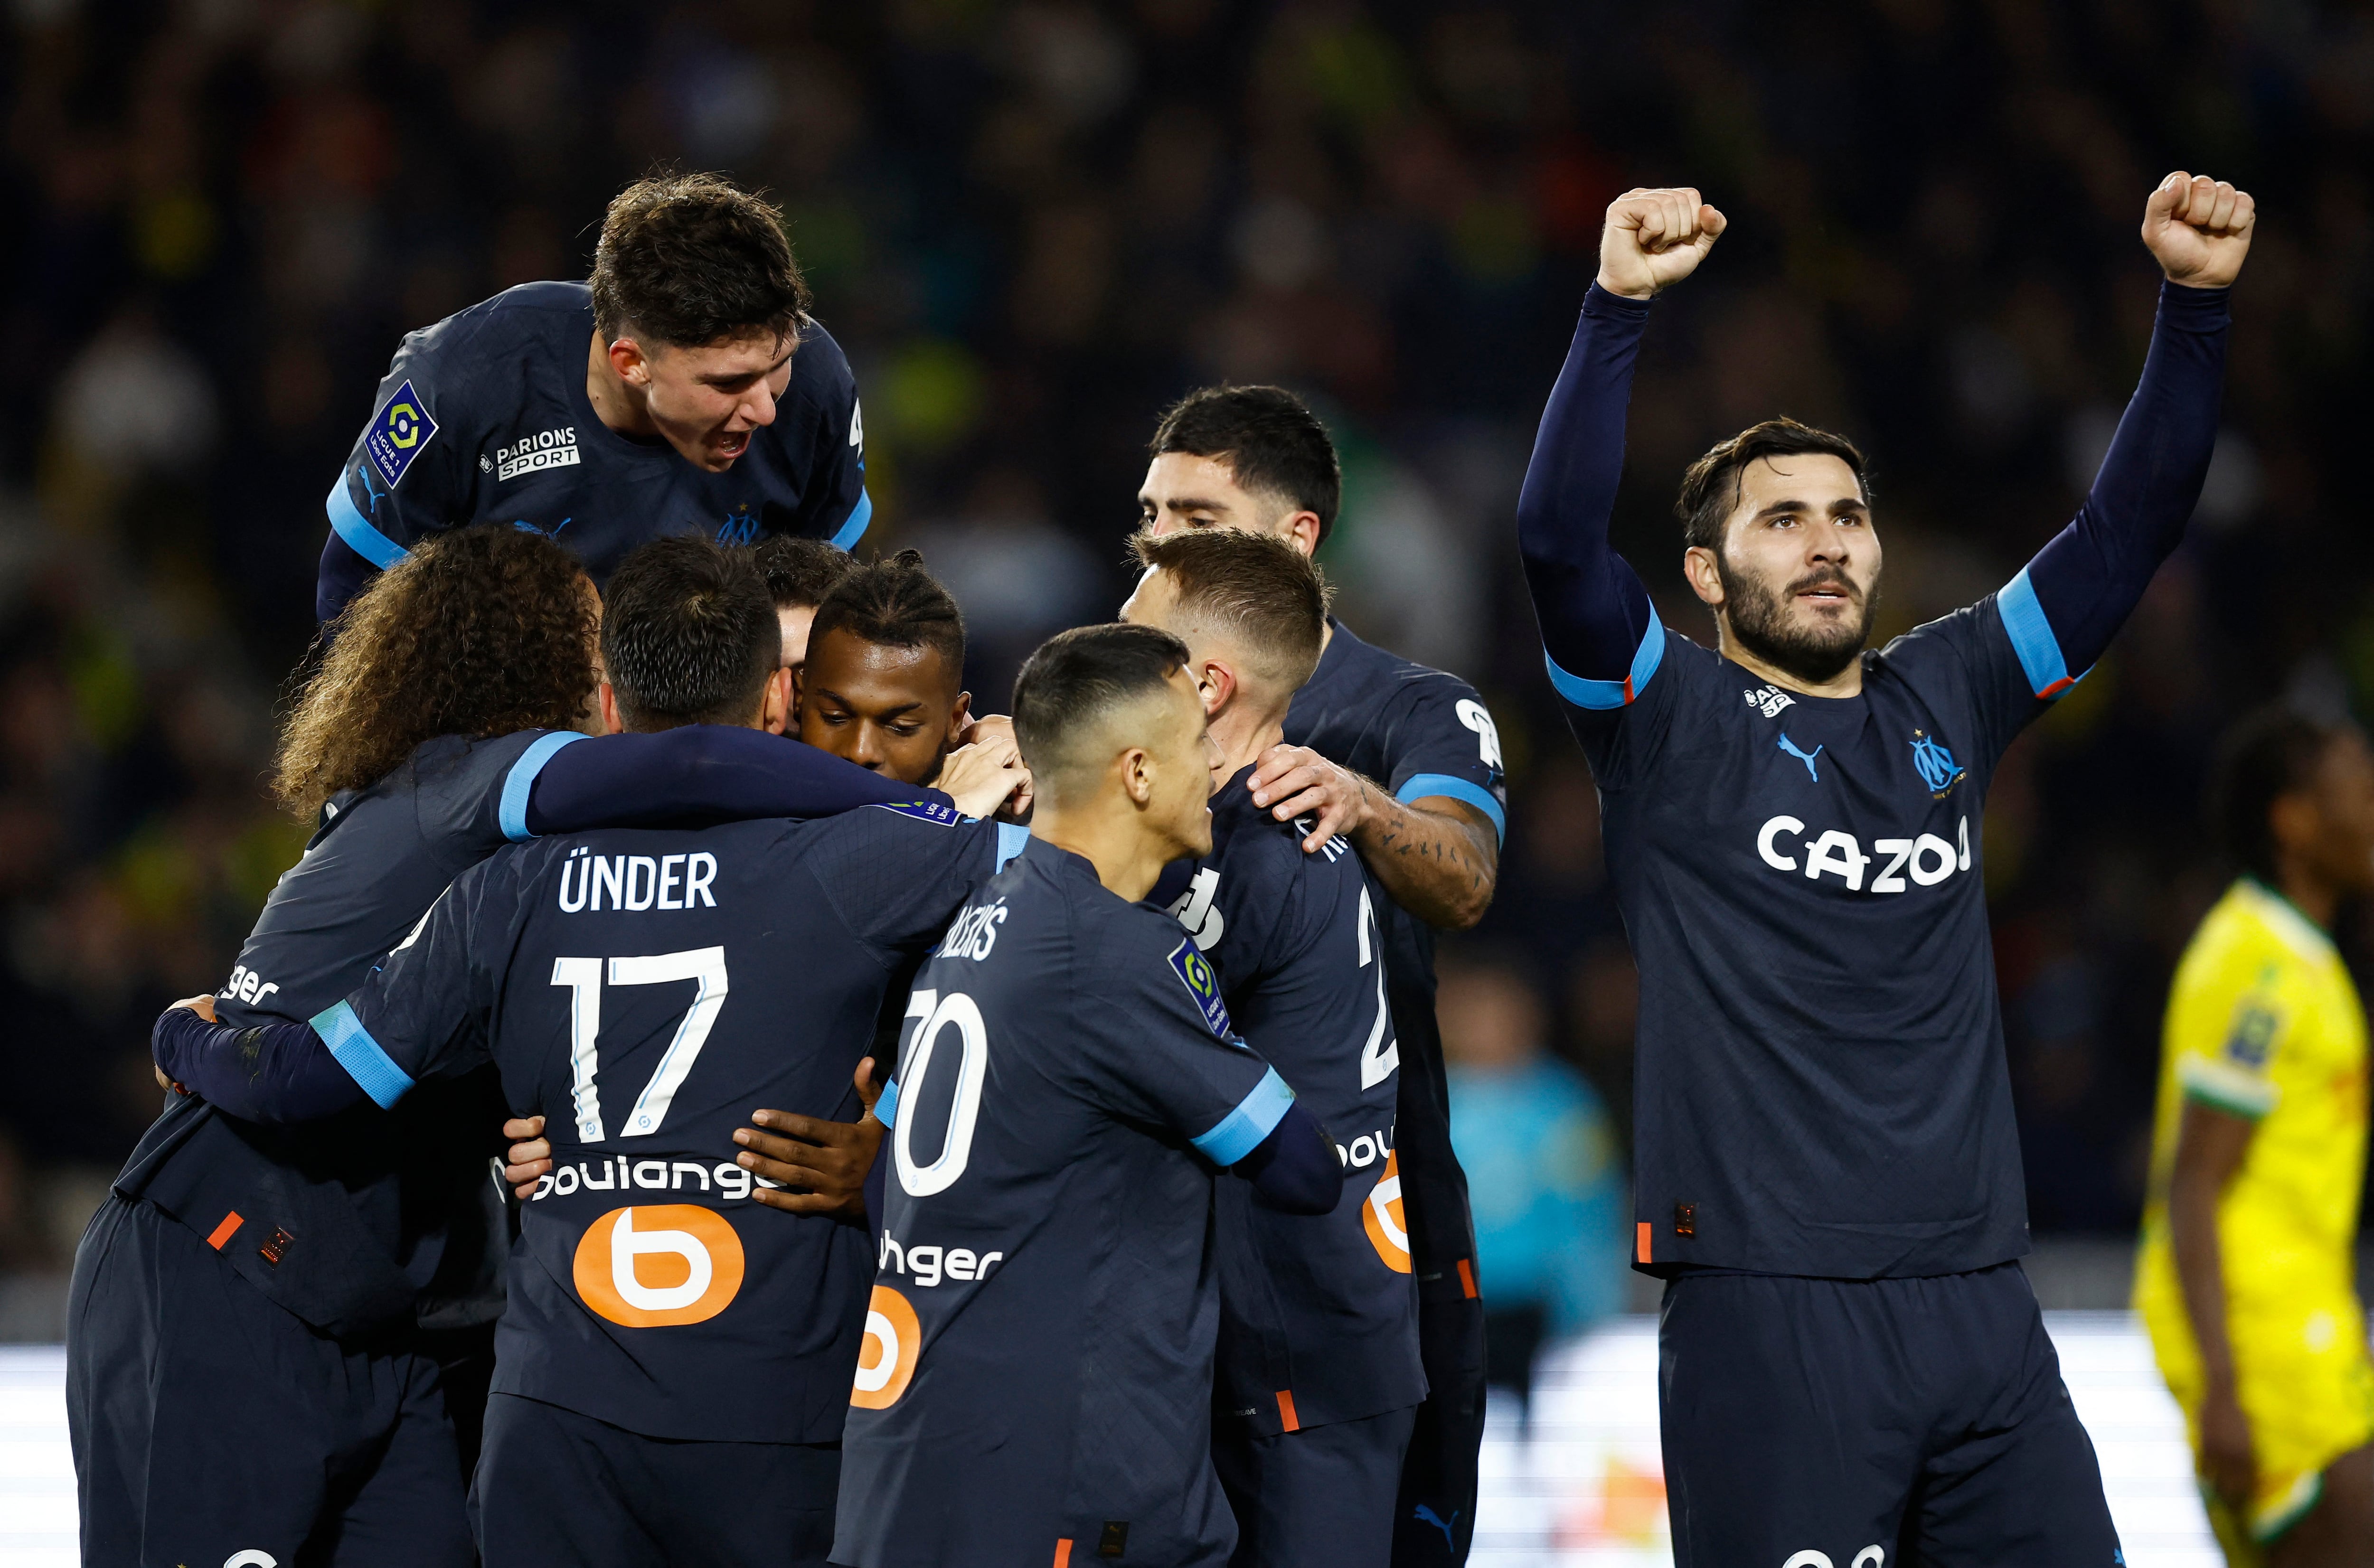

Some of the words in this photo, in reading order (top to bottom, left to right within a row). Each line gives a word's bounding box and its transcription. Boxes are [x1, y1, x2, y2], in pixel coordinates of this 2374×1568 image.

[370, 434, 382, 457] Uber
[380, 454, 395, 477] Eats
[376, 429, 396, 460] LIGUE
[497, 427, 576, 464] PARIONS
[502, 449, 575, 478] SPORT
[559, 846, 717, 913] ÜNDER
[220, 965, 280, 1006] ger
[550, 945, 728, 1144] 17
[894, 988, 988, 1197] 70
[532, 1155, 787, 1201] oulang
